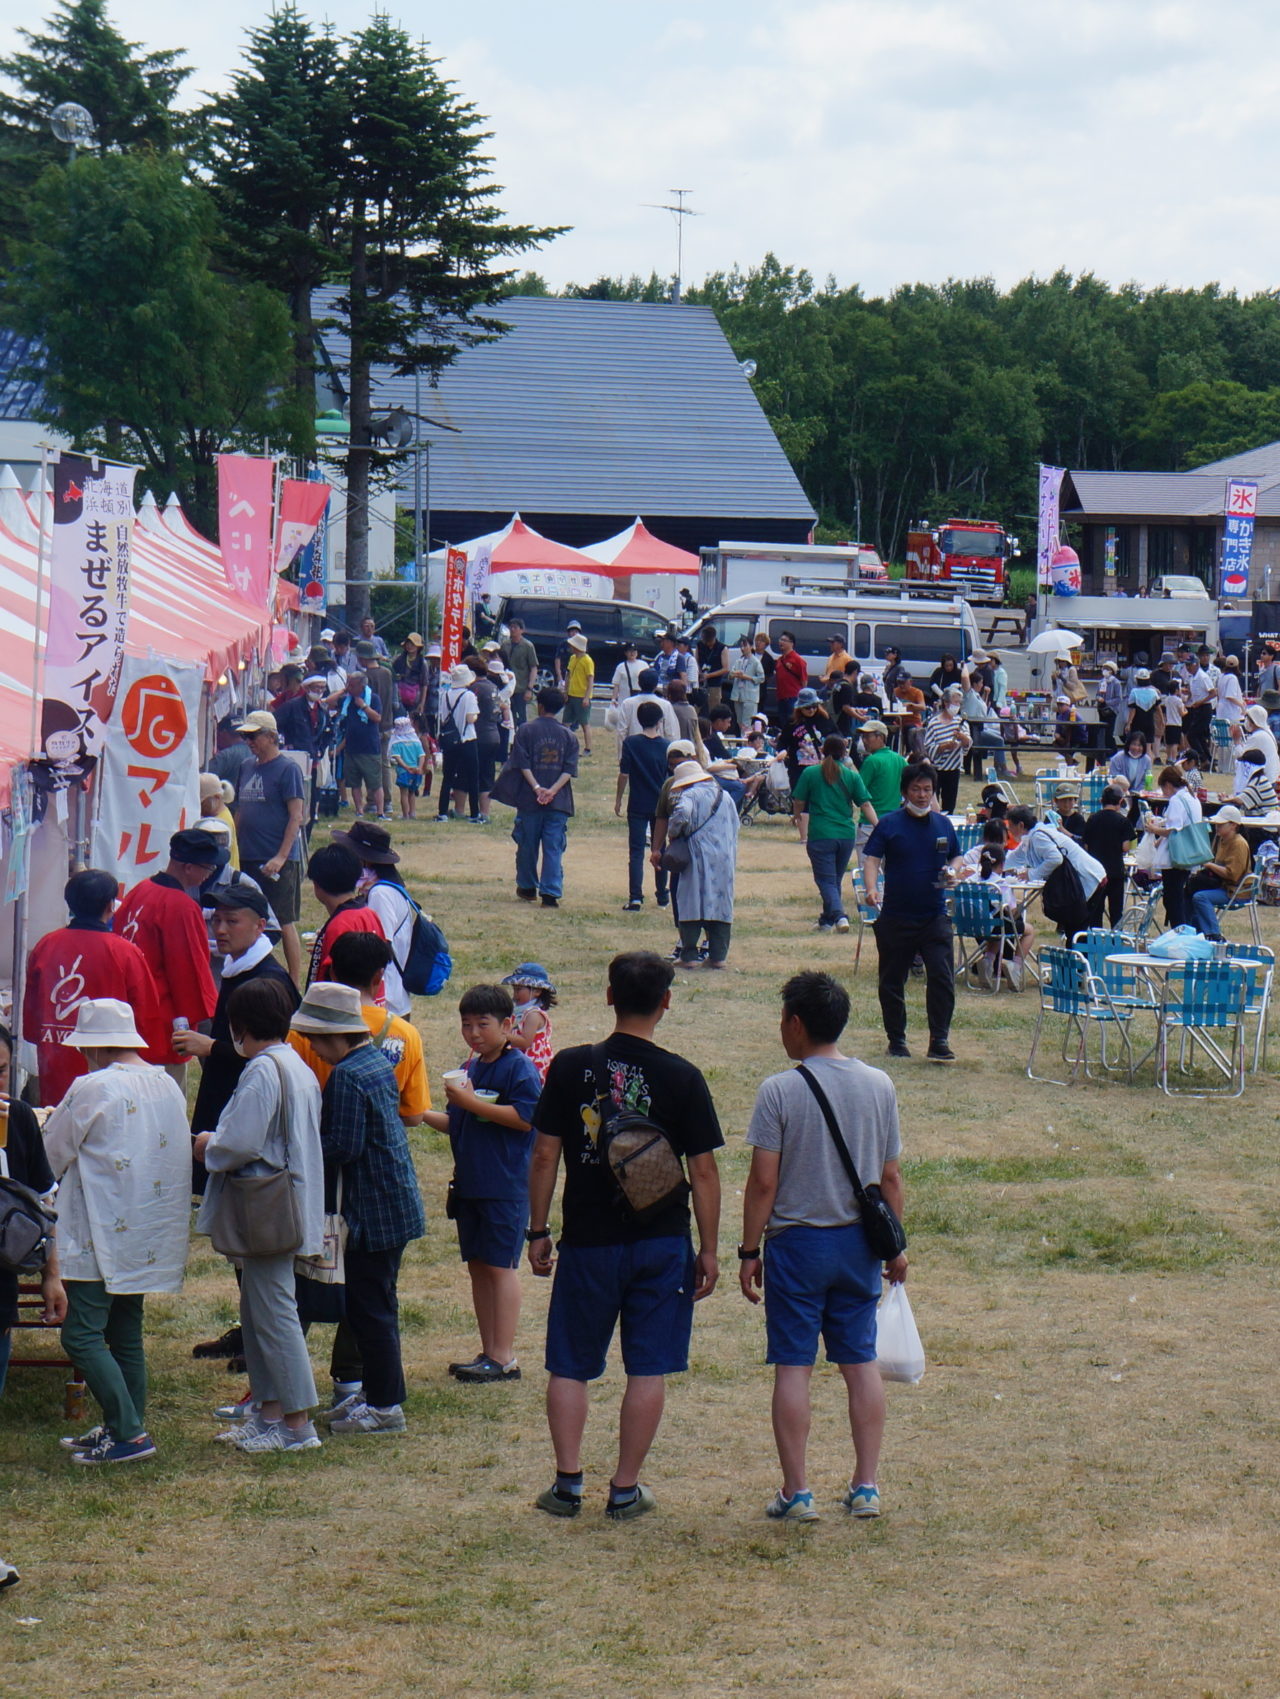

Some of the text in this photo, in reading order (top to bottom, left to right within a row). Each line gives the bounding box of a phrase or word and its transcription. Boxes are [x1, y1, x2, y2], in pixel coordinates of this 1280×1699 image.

[84, 476, 131, 498] 北海道
[86, 497, 131, 517] 浜頓別
[1233, 488, 1253, 509] 氷
[1225, 519, 1240, 571] 専門店
[1236, 520, 1254, 571] かき氷
[1068, 569, 1081, 588] 氷
[70, 519, 113, 739] まぜるアイス
